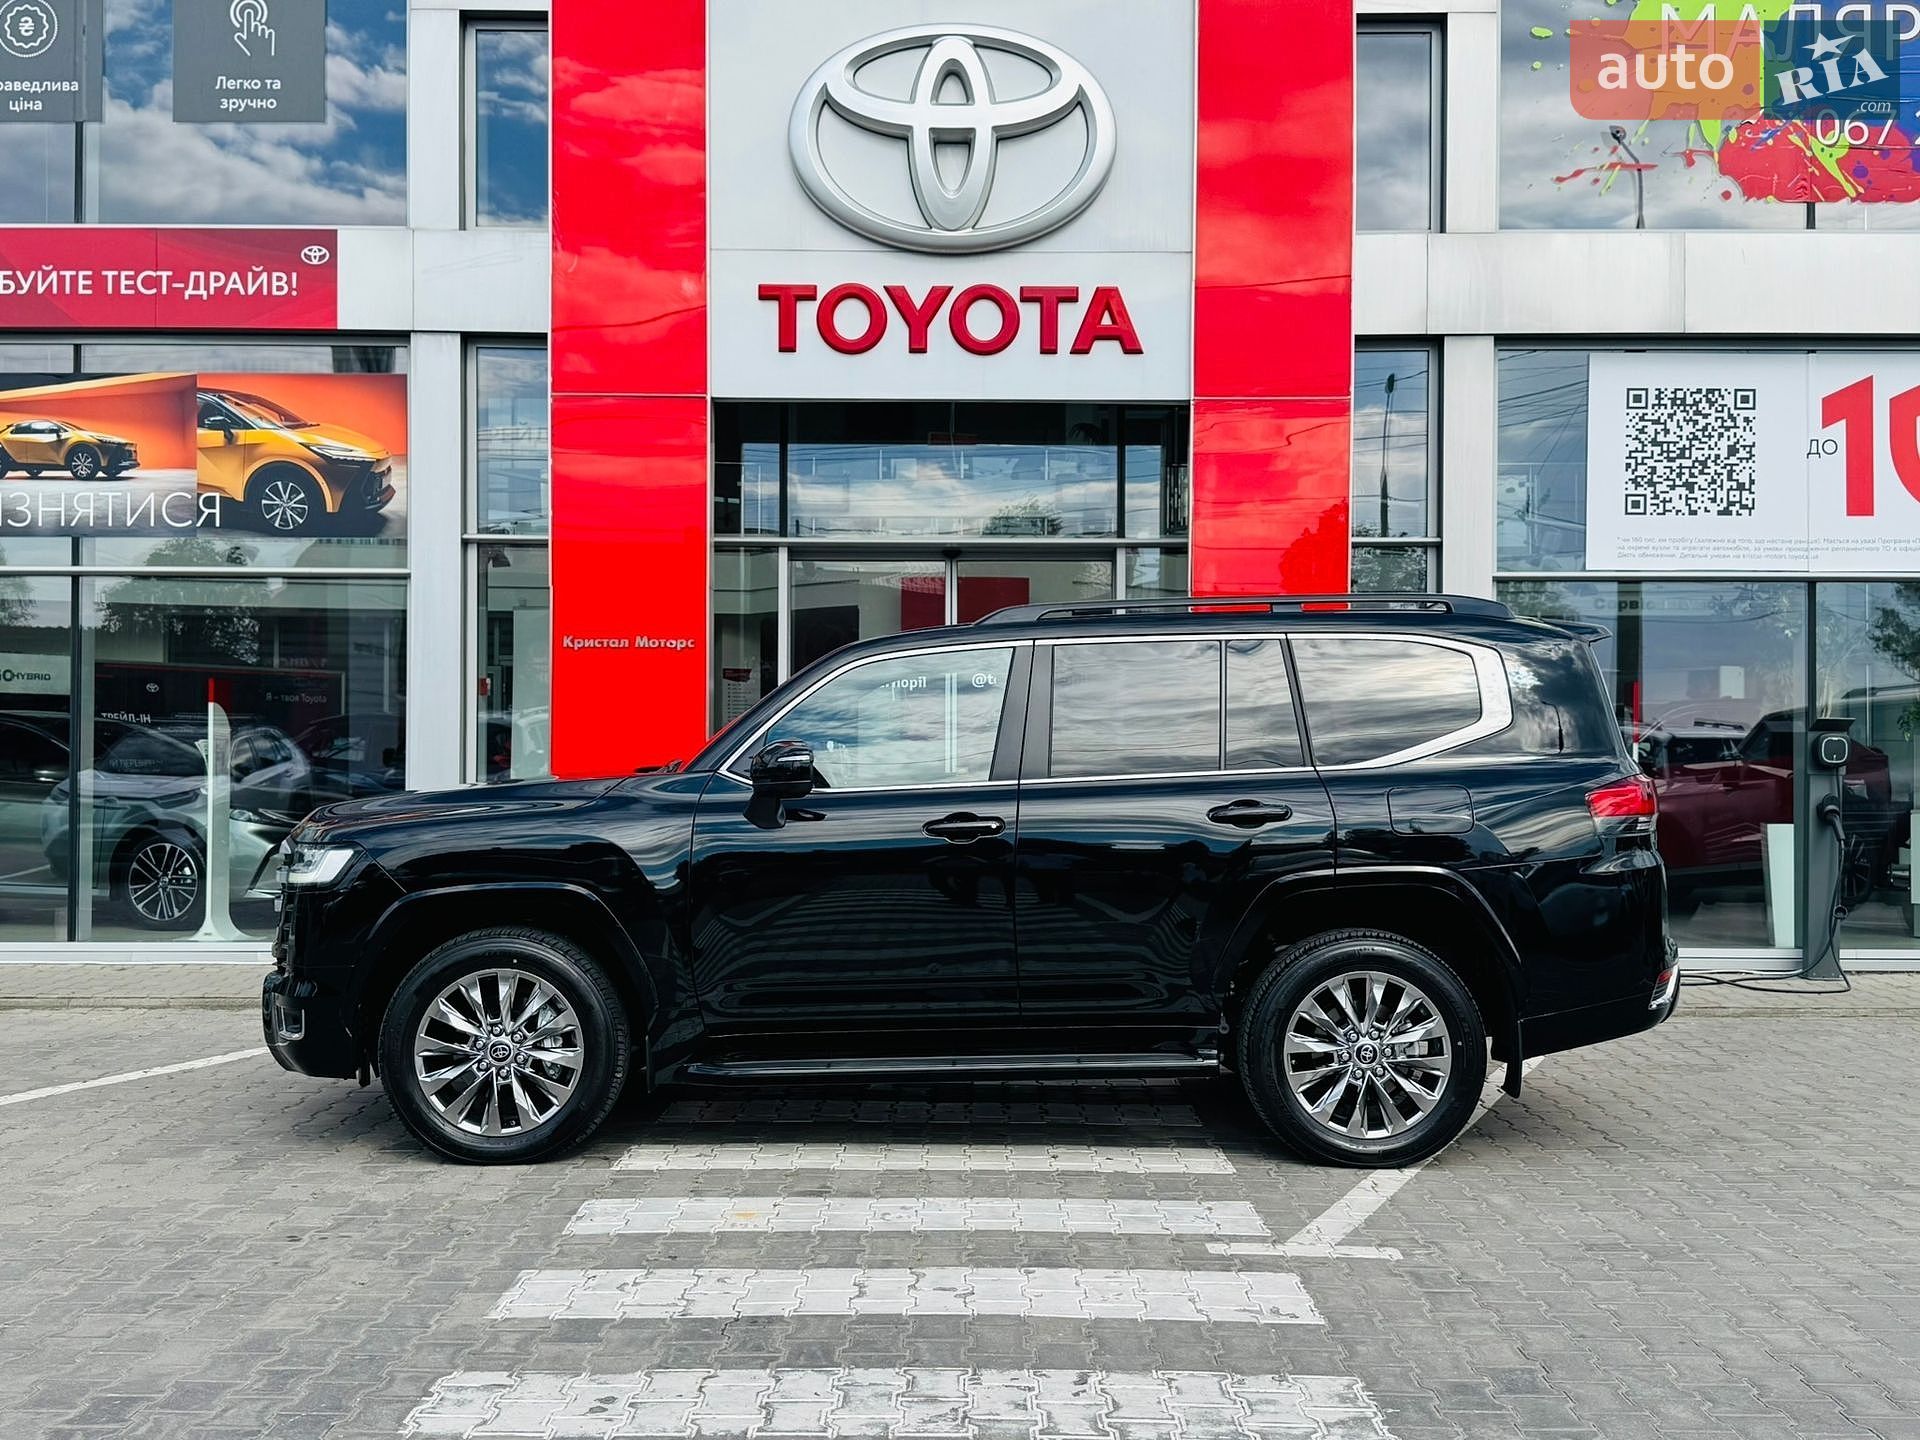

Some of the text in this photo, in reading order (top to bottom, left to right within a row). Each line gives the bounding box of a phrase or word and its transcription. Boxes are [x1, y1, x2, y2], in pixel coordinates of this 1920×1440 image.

[215, 75, 282, 90] Легко та
[9, 97, 43, 113] ціна
[219, 98, 278, 112] зручно
[1815, 109, 1898, 146] 067
[0, 264, 299, 301] БУЙТЕ ТЕСТ-ДРАЙВ!
[758, 283, 1144, 355] TOYOTA
[562, 635, 695, 650] Кристал Моторс
